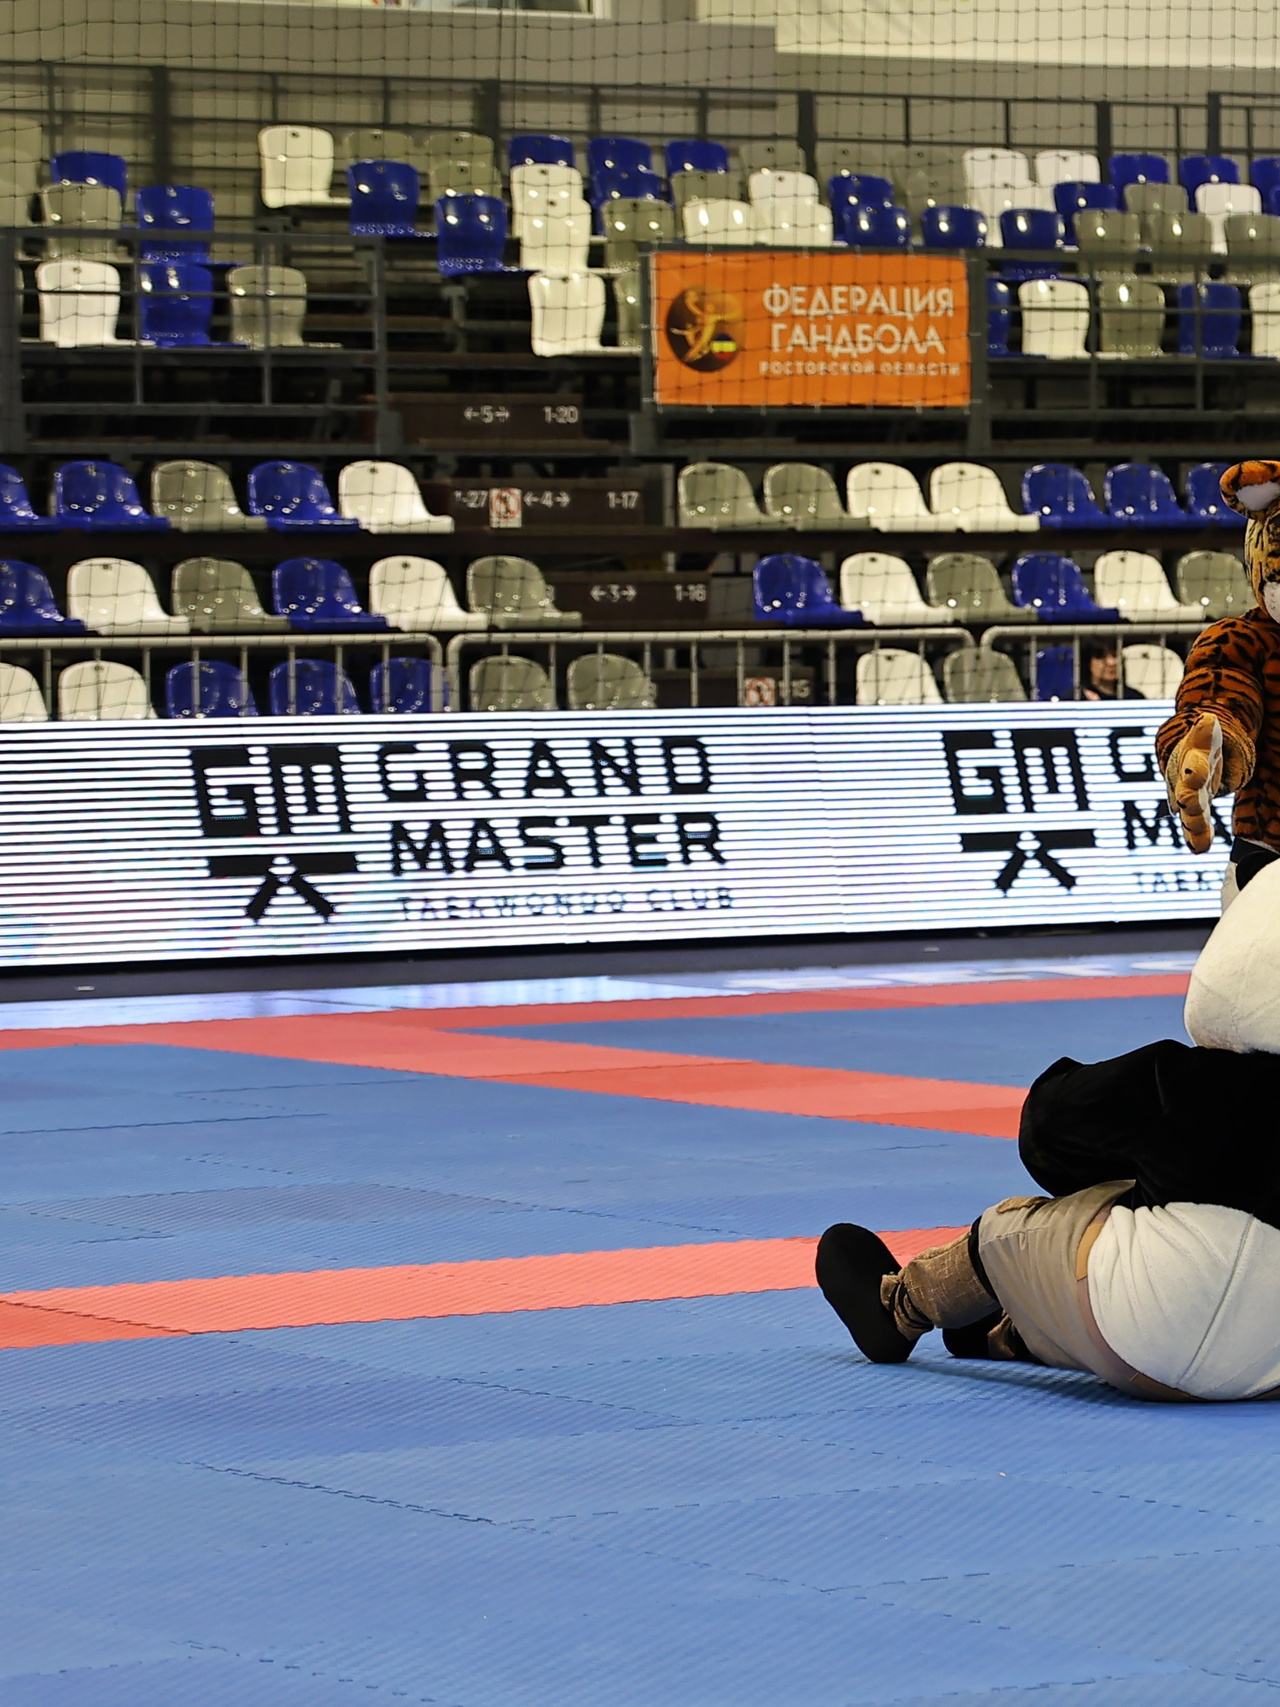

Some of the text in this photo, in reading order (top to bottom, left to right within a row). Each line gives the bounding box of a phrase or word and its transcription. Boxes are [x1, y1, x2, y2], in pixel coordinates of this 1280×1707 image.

[762, 282, 955, 320] ФЕДЕРАЦИЯ
[770, 323, 946, 358] ГАНДБОЛА
[758, 360, 961, 376] РОСТОВСКОЙ ОБЛАСТИ
[542, 405, 580, 424] 1-20
[607, 490, 639, 508] 1-17
[190, 738, 710, 838] GM GRAND
[944, 729, 1091, 815] GM
[391, 813, 727, 876] MASTER
